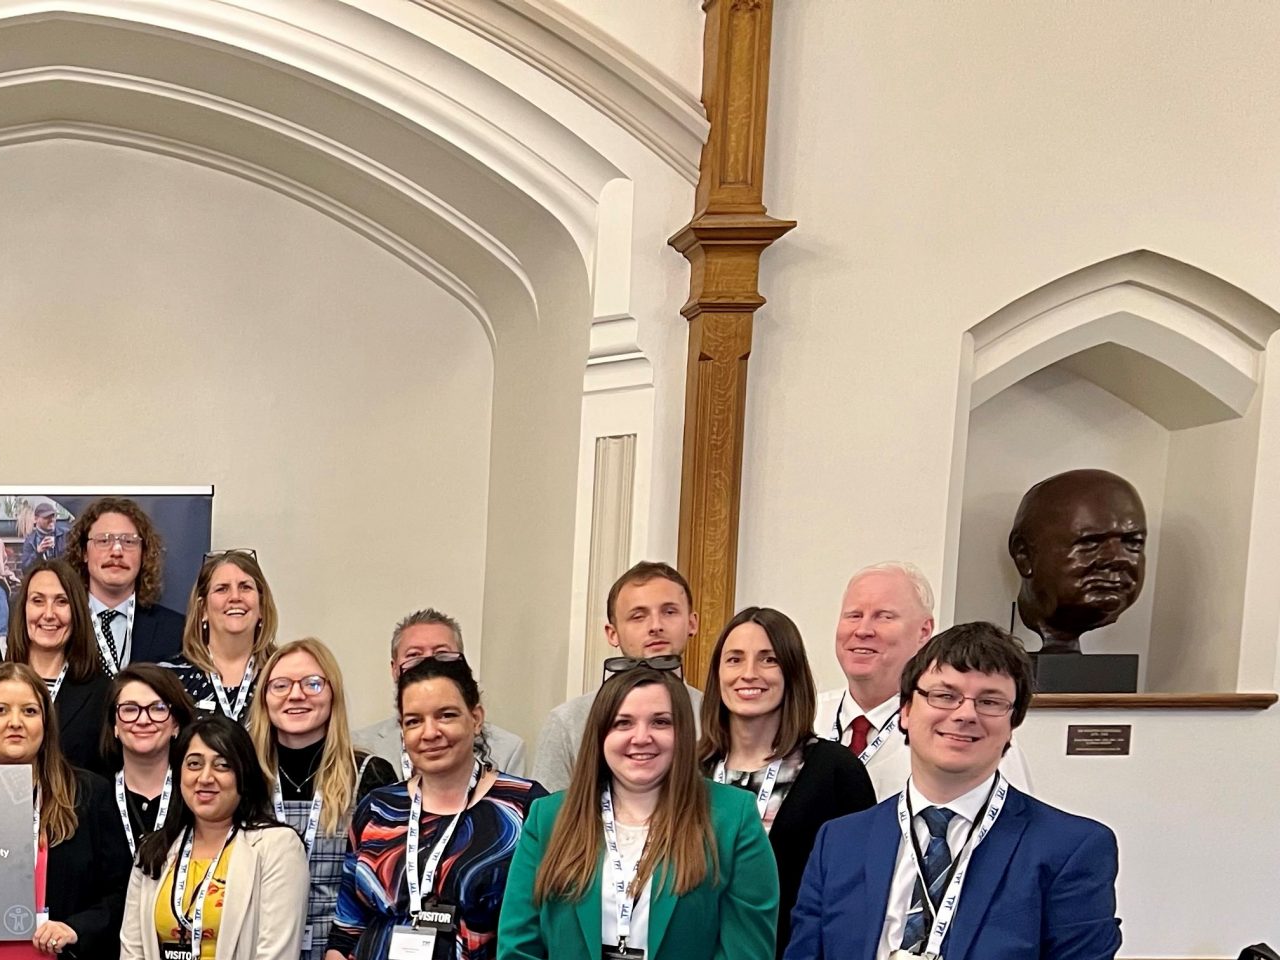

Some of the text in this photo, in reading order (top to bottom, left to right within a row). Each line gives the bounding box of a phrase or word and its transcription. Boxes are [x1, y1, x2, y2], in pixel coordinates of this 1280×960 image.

[885, 720, 896, 734] TPT
[871, 736, 882, 749] TPT
[766, 768, 776, 780] TPT
[759, 789, 769, 801] TPT
[418, 911, 451, 923] VISITOR
[934, 921, 947, 936] TPT
[164, 950, 192, 960] VISITO
